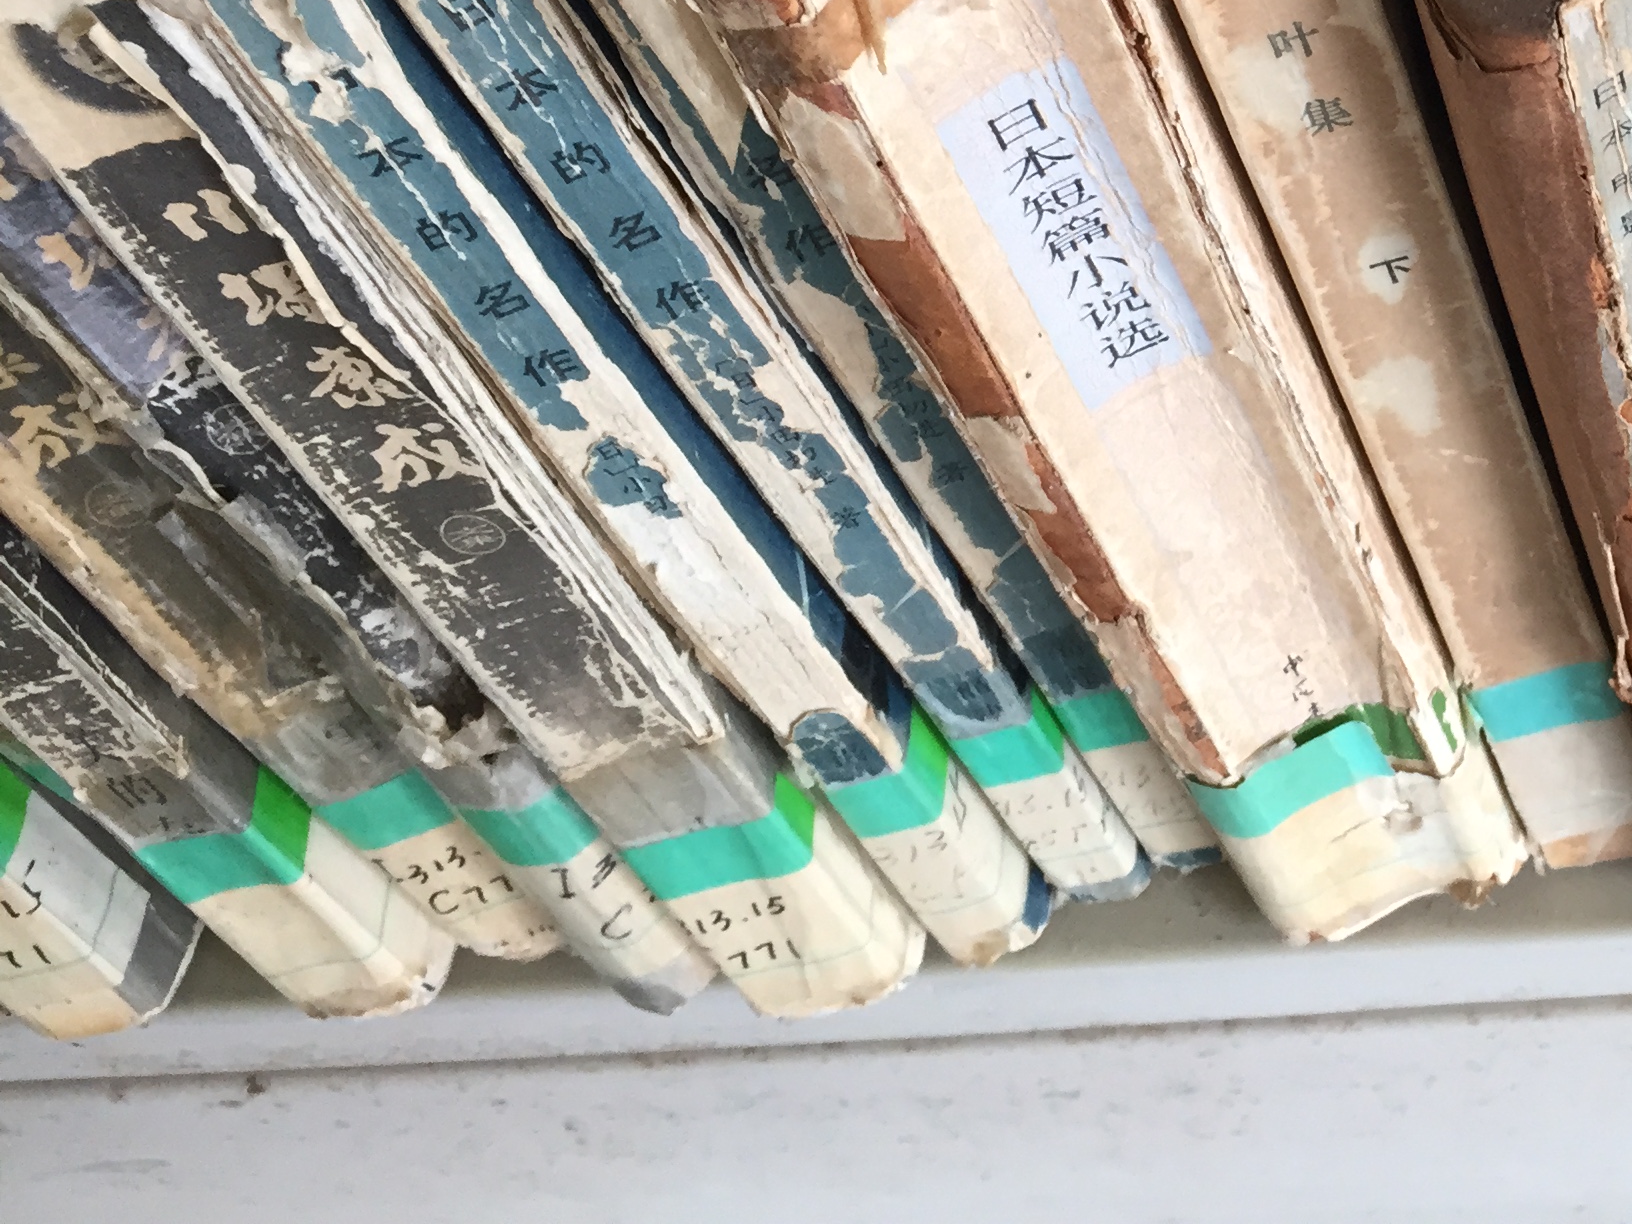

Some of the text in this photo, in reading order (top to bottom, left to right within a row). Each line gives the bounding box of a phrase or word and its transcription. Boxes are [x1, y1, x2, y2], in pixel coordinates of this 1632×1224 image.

[987, 98, 1170, 368] 日本短篇小说选
[1369, 255, 1411, 284] 下
